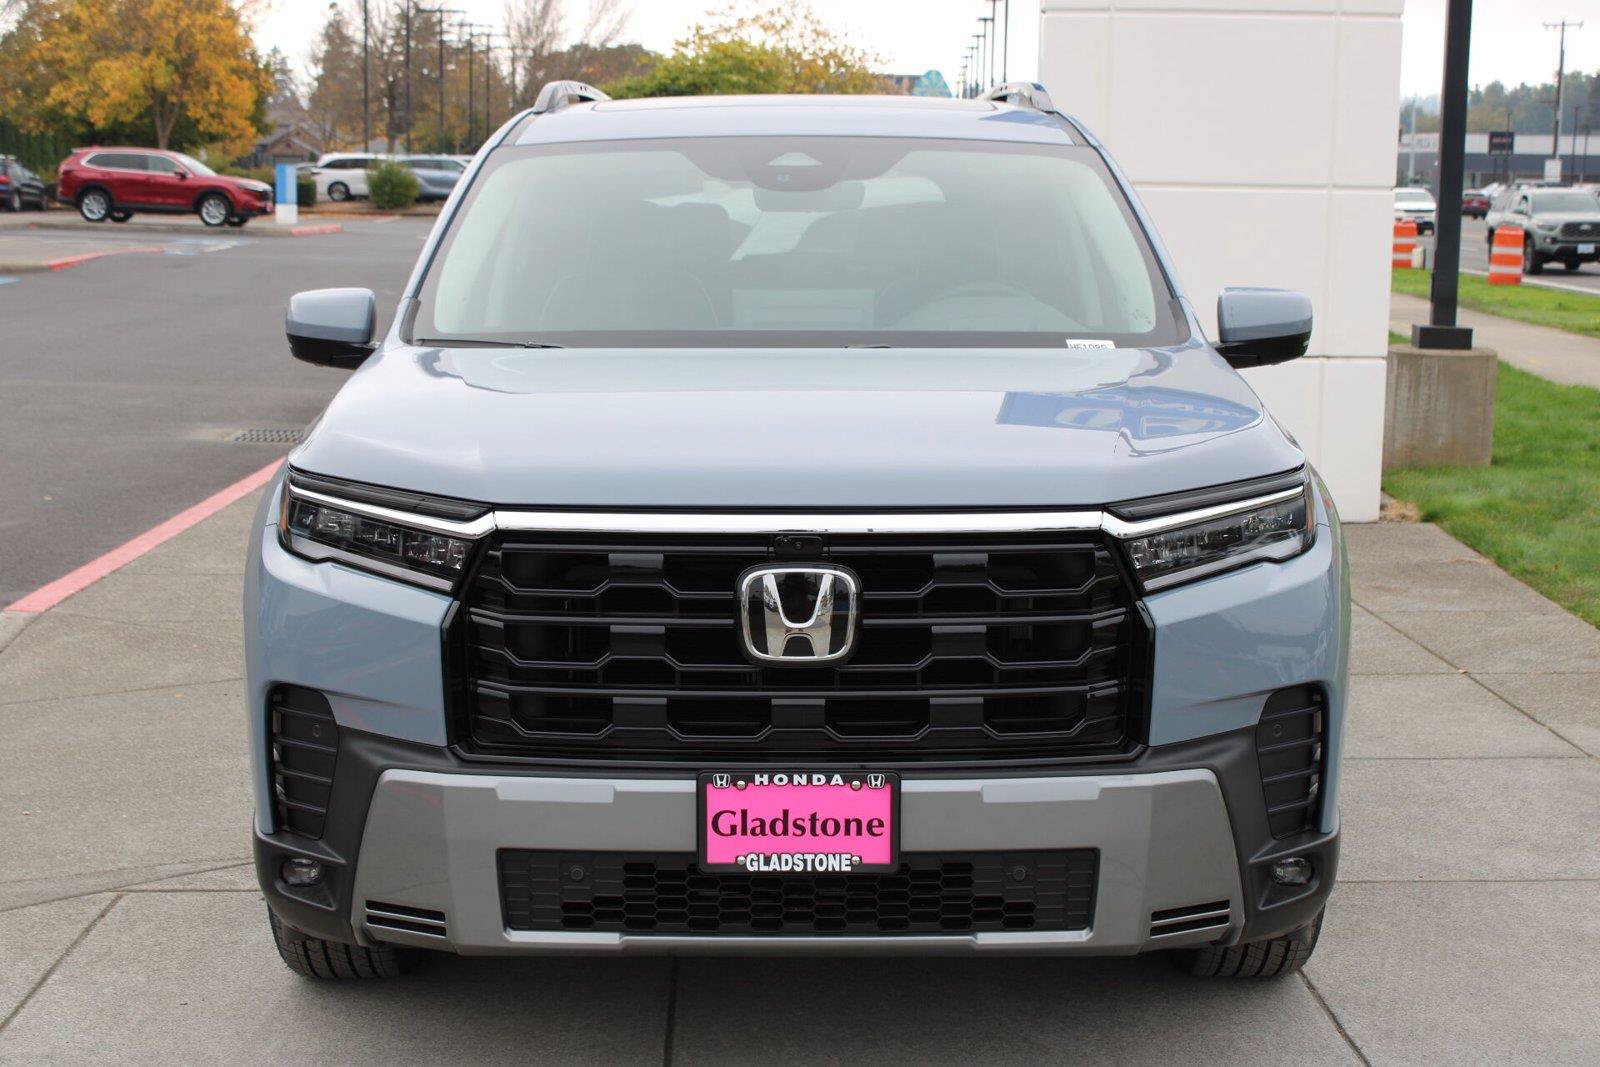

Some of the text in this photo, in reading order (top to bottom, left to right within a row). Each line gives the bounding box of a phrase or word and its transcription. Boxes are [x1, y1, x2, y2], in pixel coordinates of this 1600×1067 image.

[754, 774, 844, 786] HONDA
[711, 809, 885, 837] Gladstone
[746, 854, 852, 871] GLADSTONE
